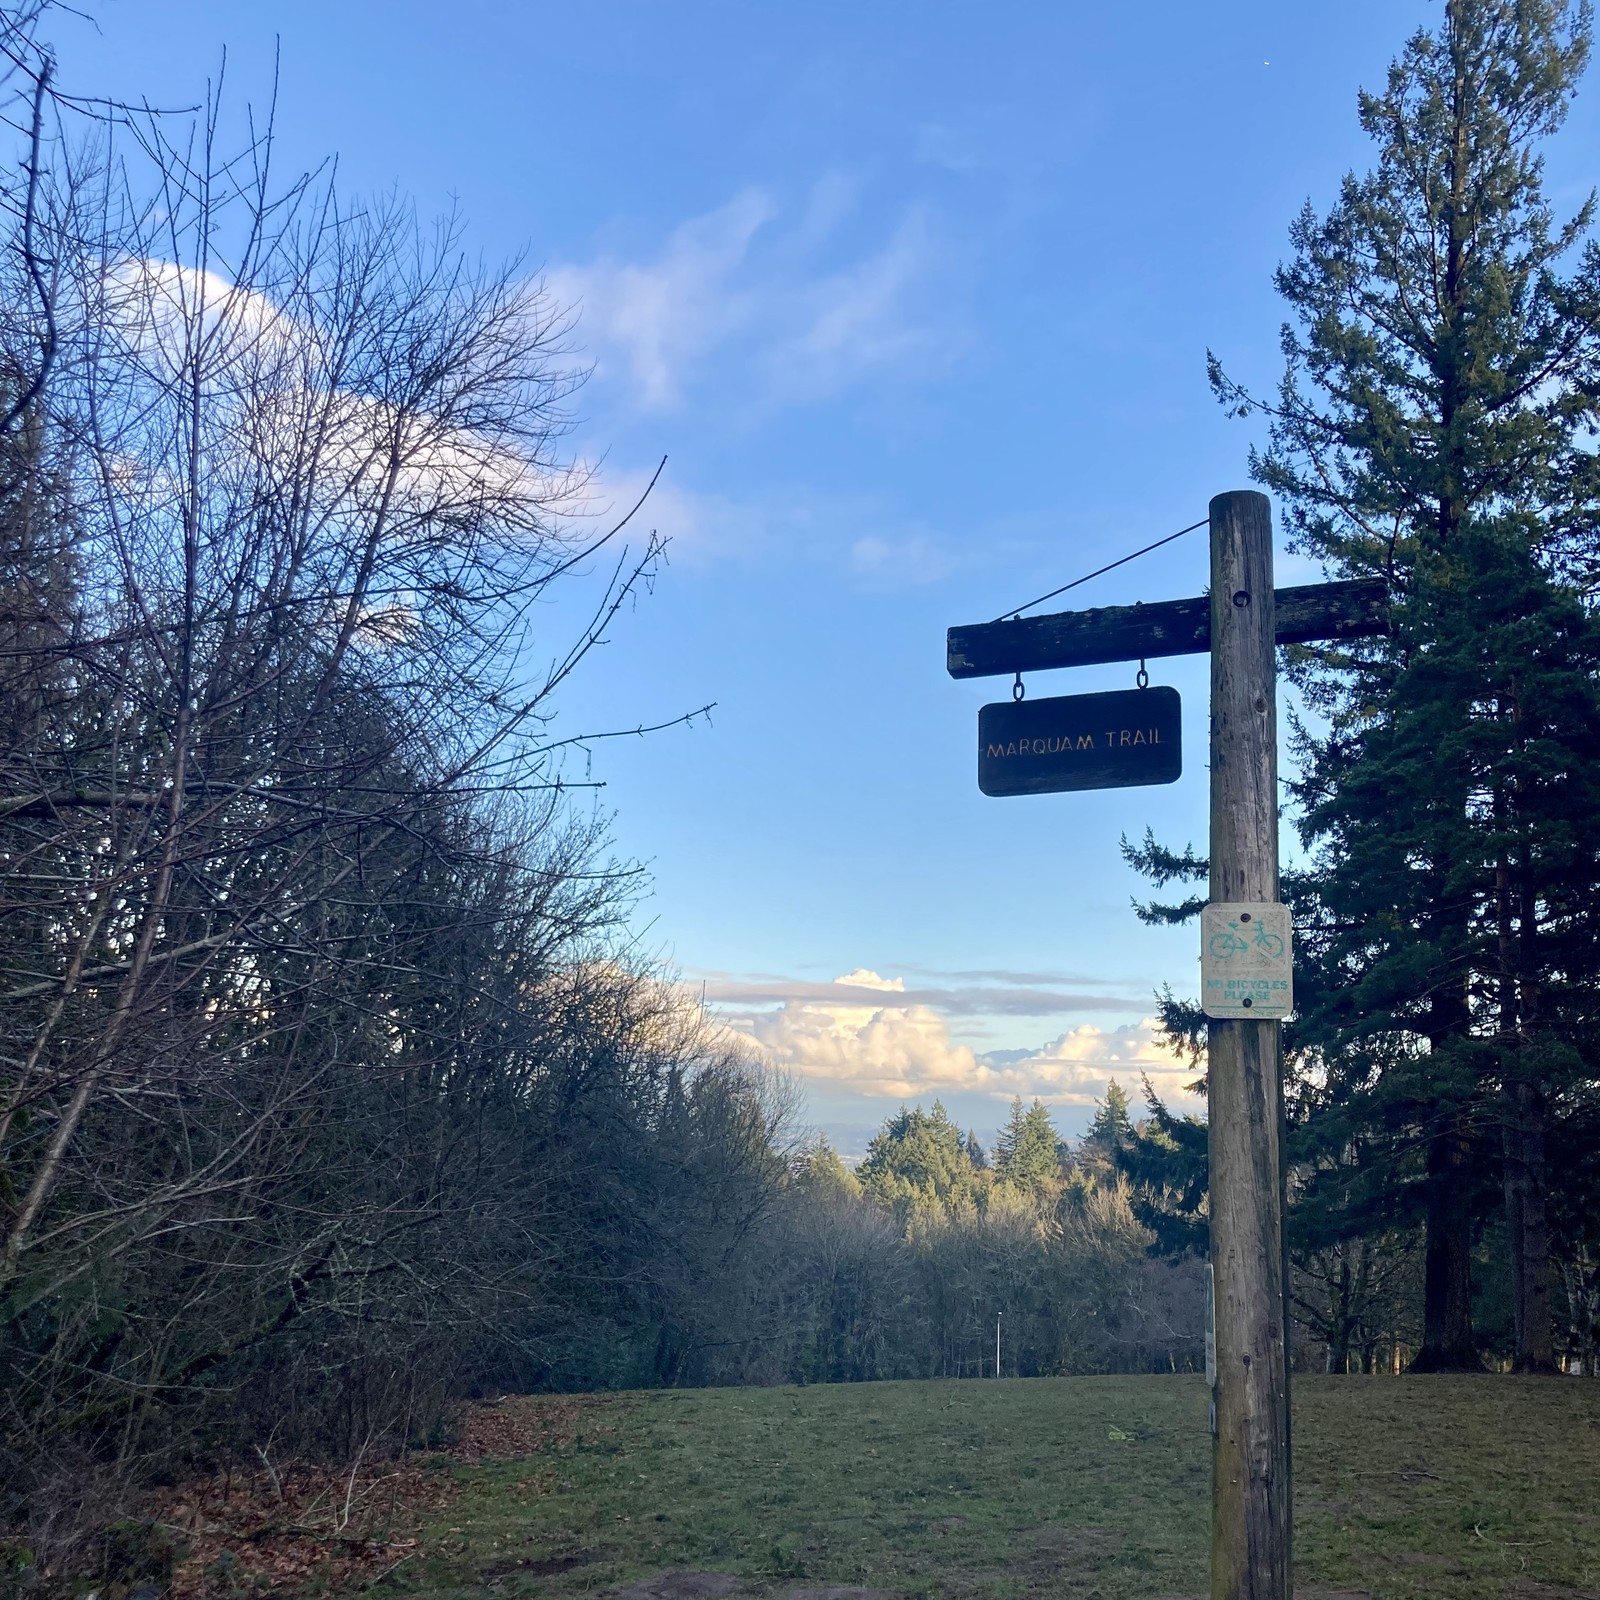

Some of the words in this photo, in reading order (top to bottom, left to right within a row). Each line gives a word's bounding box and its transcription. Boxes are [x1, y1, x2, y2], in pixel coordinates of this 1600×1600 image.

[987, 735, 1094, 758] MARQUAM
[1106, 728, 1167, 747] TRAIL
[1206, 980, 1223, 989] NO
[1227, 980, 1288, 990] BICYCLES
[1224, 990, 1271, 1000] PLEASE
